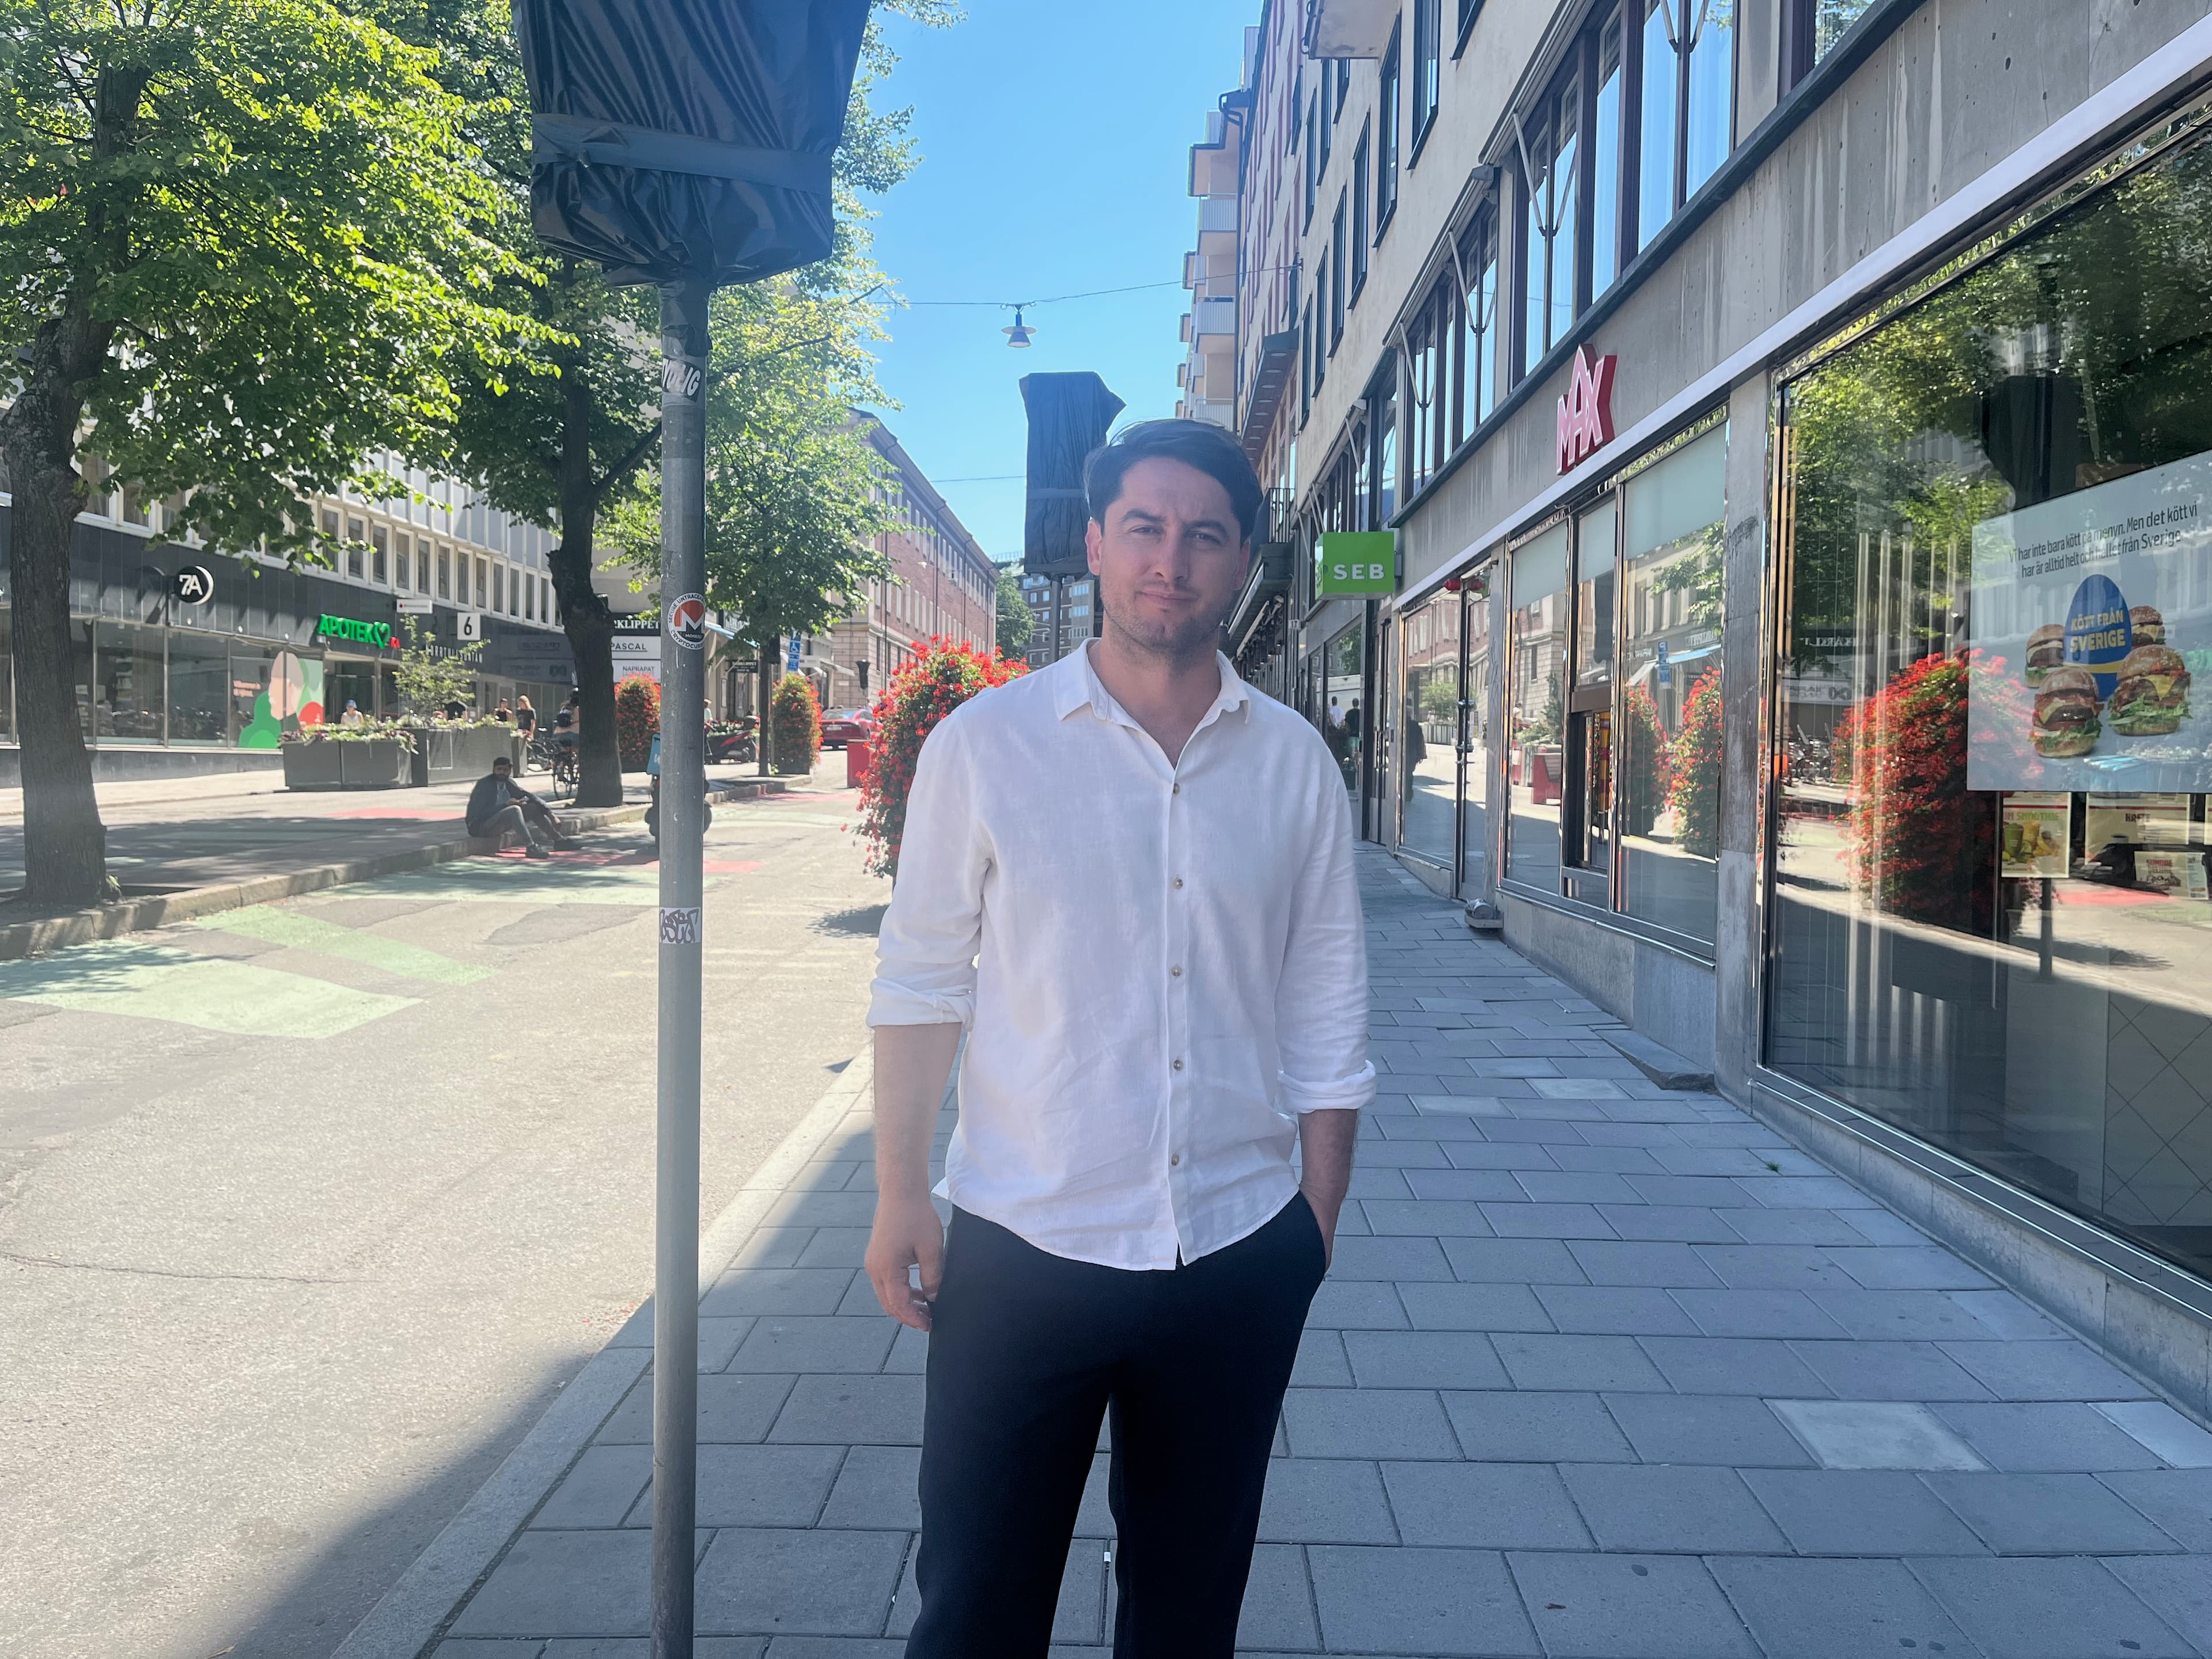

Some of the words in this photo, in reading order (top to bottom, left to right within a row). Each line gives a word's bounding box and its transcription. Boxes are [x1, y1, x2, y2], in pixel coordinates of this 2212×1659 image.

[1556, 344, 1608, 476] MAX
[2018, 547, 2031, 560] har
[2032, 544, 2046, 557] inte
[2047, 539, 2065, 554] bara
[2066, 532, 2081, 548] kött
[2127, 517, 2144, 533] Men
[2146, 511, 2165, 527] det
[2168, 505, 2187, 523] kött
[2189, 500, 2197, 517] vi
[2022, 564, 2035, 578] har
[2036, 560, 2043, 575] är
[2044, 555, 2064, 573] alltid
[2065, 552, 2079, 568] helt
[2122, 536, 2139, 554] från
[1334, 563, 1384, 580] SEB
[179, 574, 203, 595] 7A
[669, 603, 677, 623] SECURE
[2070, 613, 2095, 631] KÖTT
[2097, 607, 2124, 625] FRÅN
[318, 613, 374, 643] APOTEK
[463, 616, 472, 635] 6
[2069, 628, 2126, 653] SVERIGE
